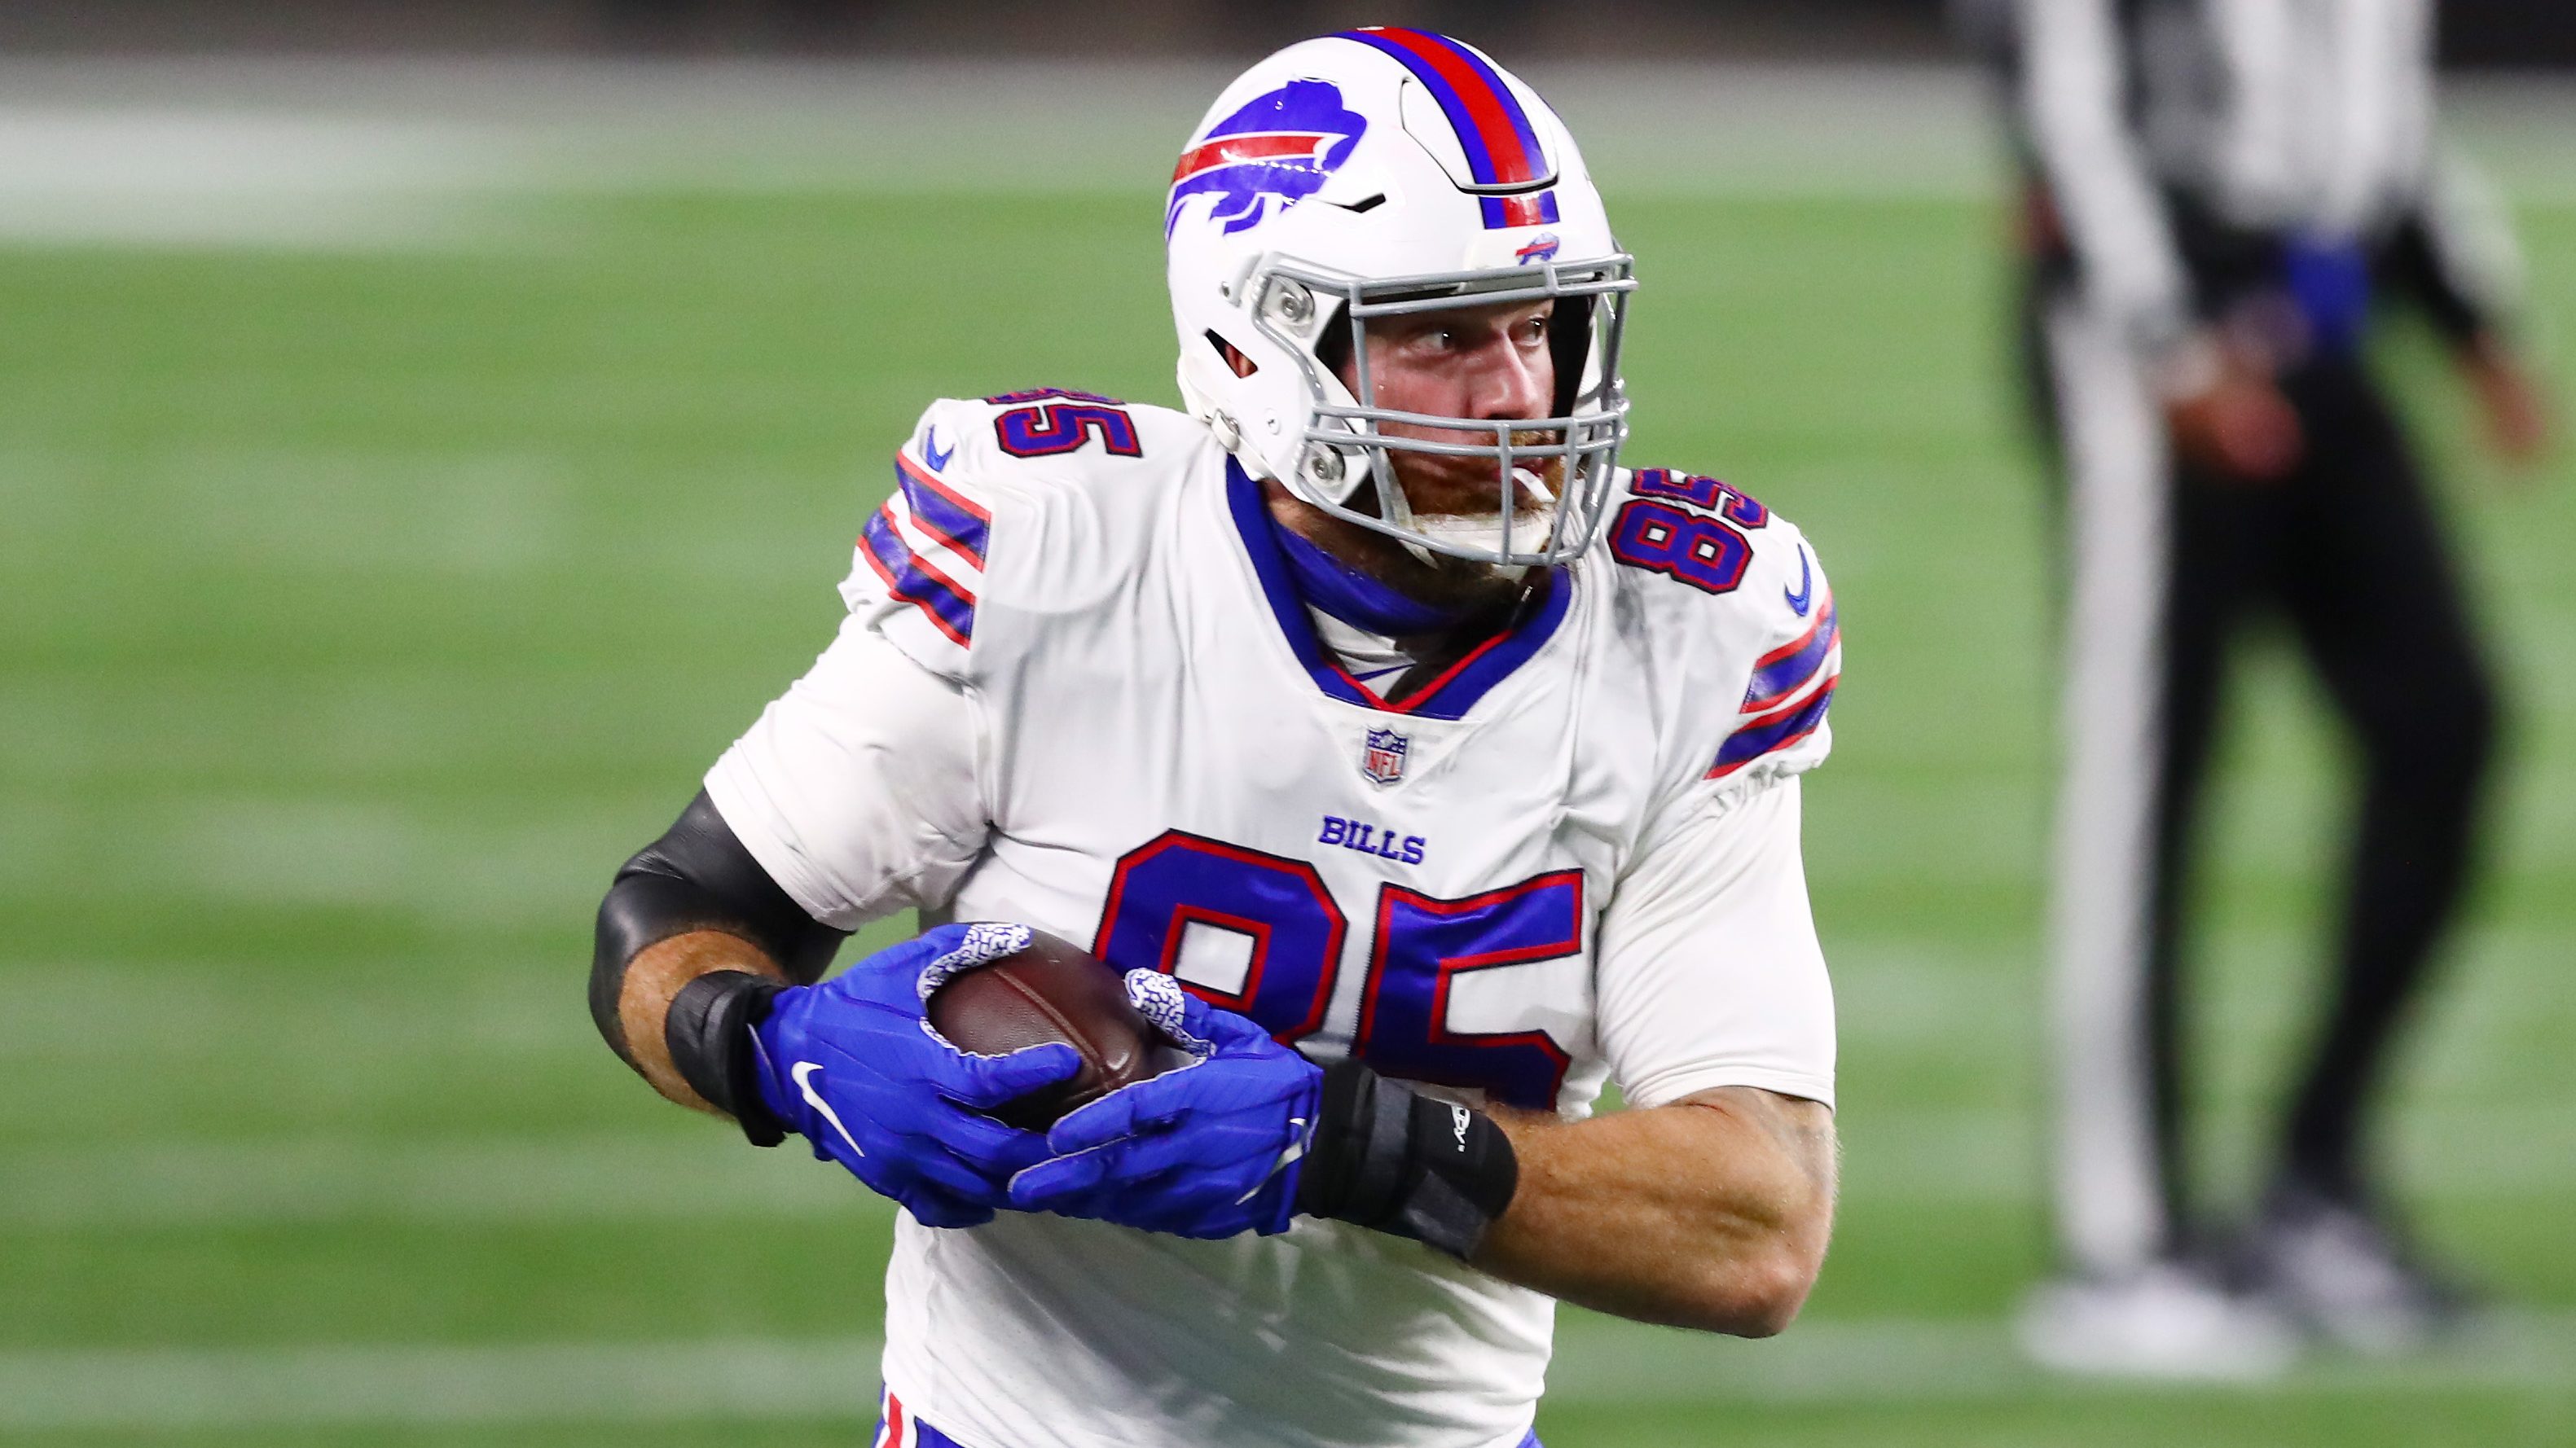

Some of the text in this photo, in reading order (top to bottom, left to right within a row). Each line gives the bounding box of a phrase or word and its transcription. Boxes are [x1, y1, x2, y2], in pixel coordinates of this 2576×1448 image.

[983, 387, 1144, 458] 5
[1607, 467, 1769, 595] 85
[1365, 749, 1402, 777] NFL
[1318, 815, 1426, 865] BILLS
